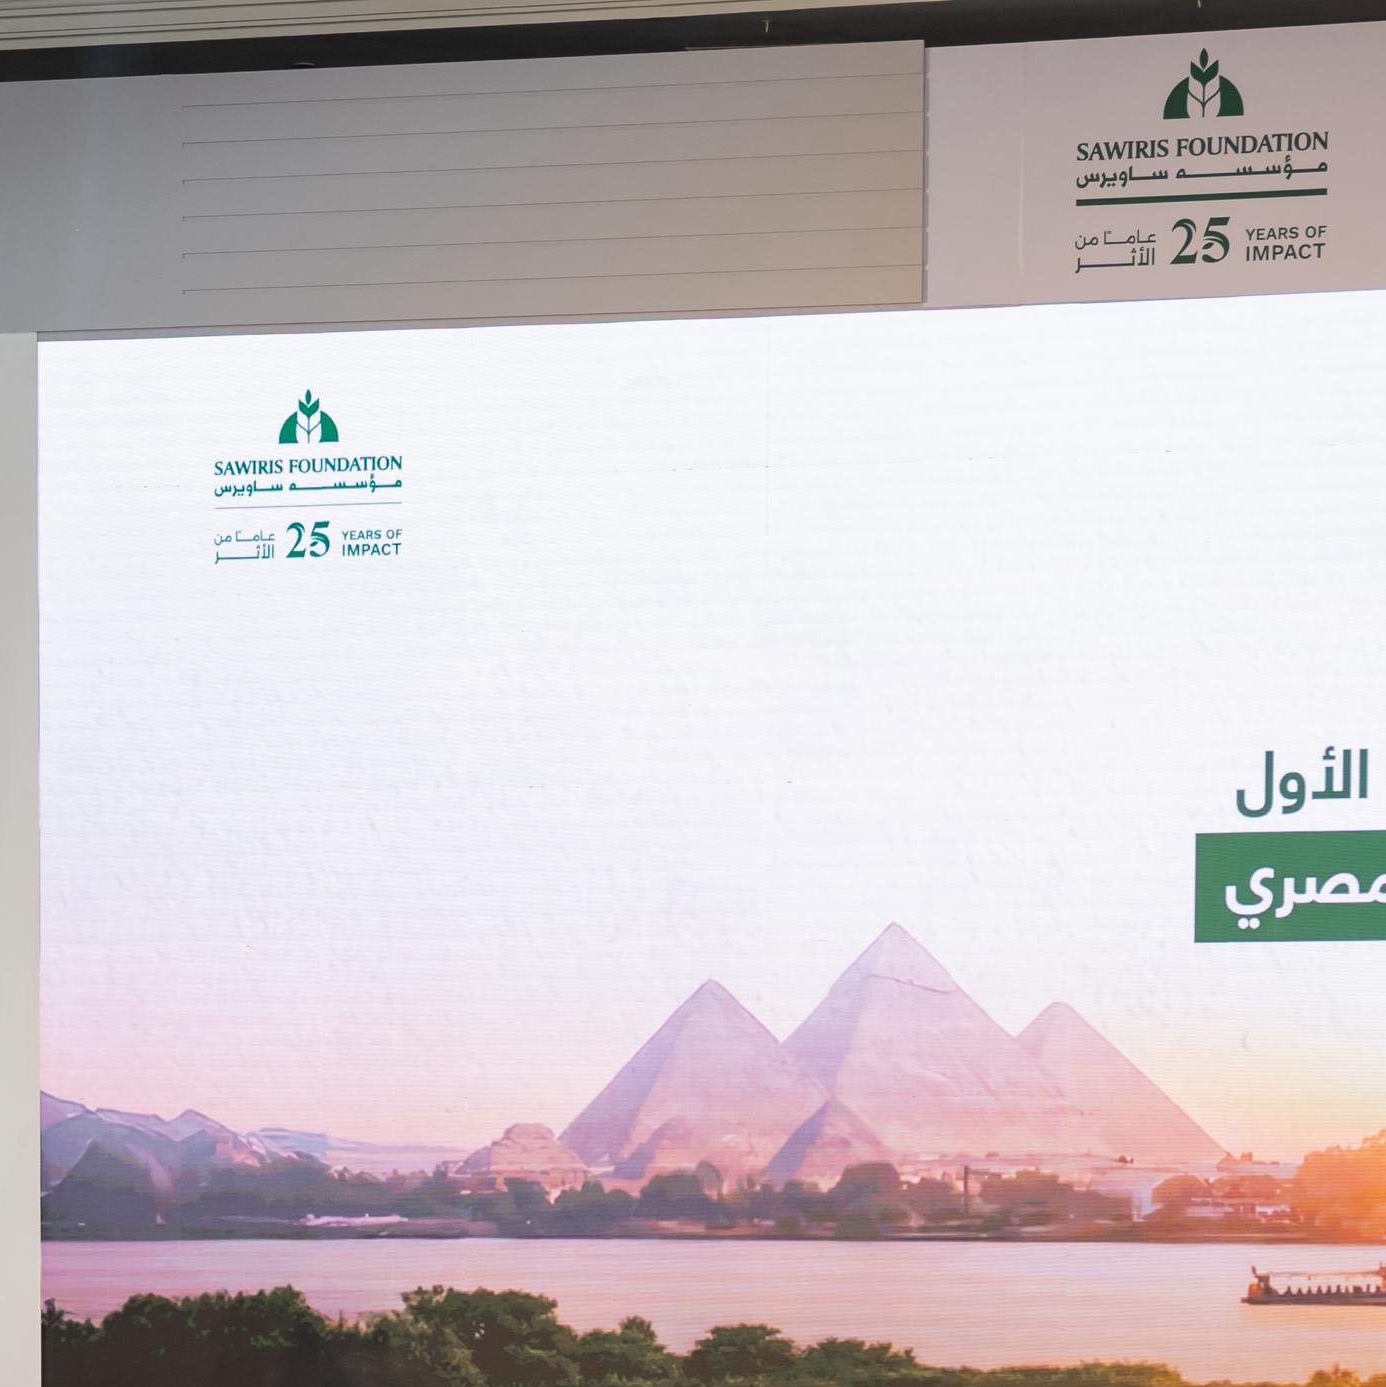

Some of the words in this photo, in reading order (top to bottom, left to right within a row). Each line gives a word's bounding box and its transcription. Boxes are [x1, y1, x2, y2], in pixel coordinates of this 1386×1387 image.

[1076, 139, 1169, 161] SAWIRIS
[1176, 131, 1329, 157] FOUNDATION
[1076, 166, 1169, 188] ساويرس
[1074, 235, 1099, 249] من
[1169, 216, 1231, 265] 25
[1245, 227, 1299, 241] YEARS
[1305, 225, 1328, 239] OF
[1074, 247, 1156, 274] الأثر
[1245, 243, 1326, 262] IMPACT
[214, 459, 283, 476] SAWIRIS
[289, 456, 403, 474] FOUNDATION
[214, 480, 283, 497] ساويرس
[214, 534, 232, 546] من
[286, 520, 331, 559] 25
[342, 530, 382, 541] YEARS
[386, 529, 403, 540] OF
[342, 543, 402, 557] IMPACT
[1235, 746, 1369, 818] الأول
